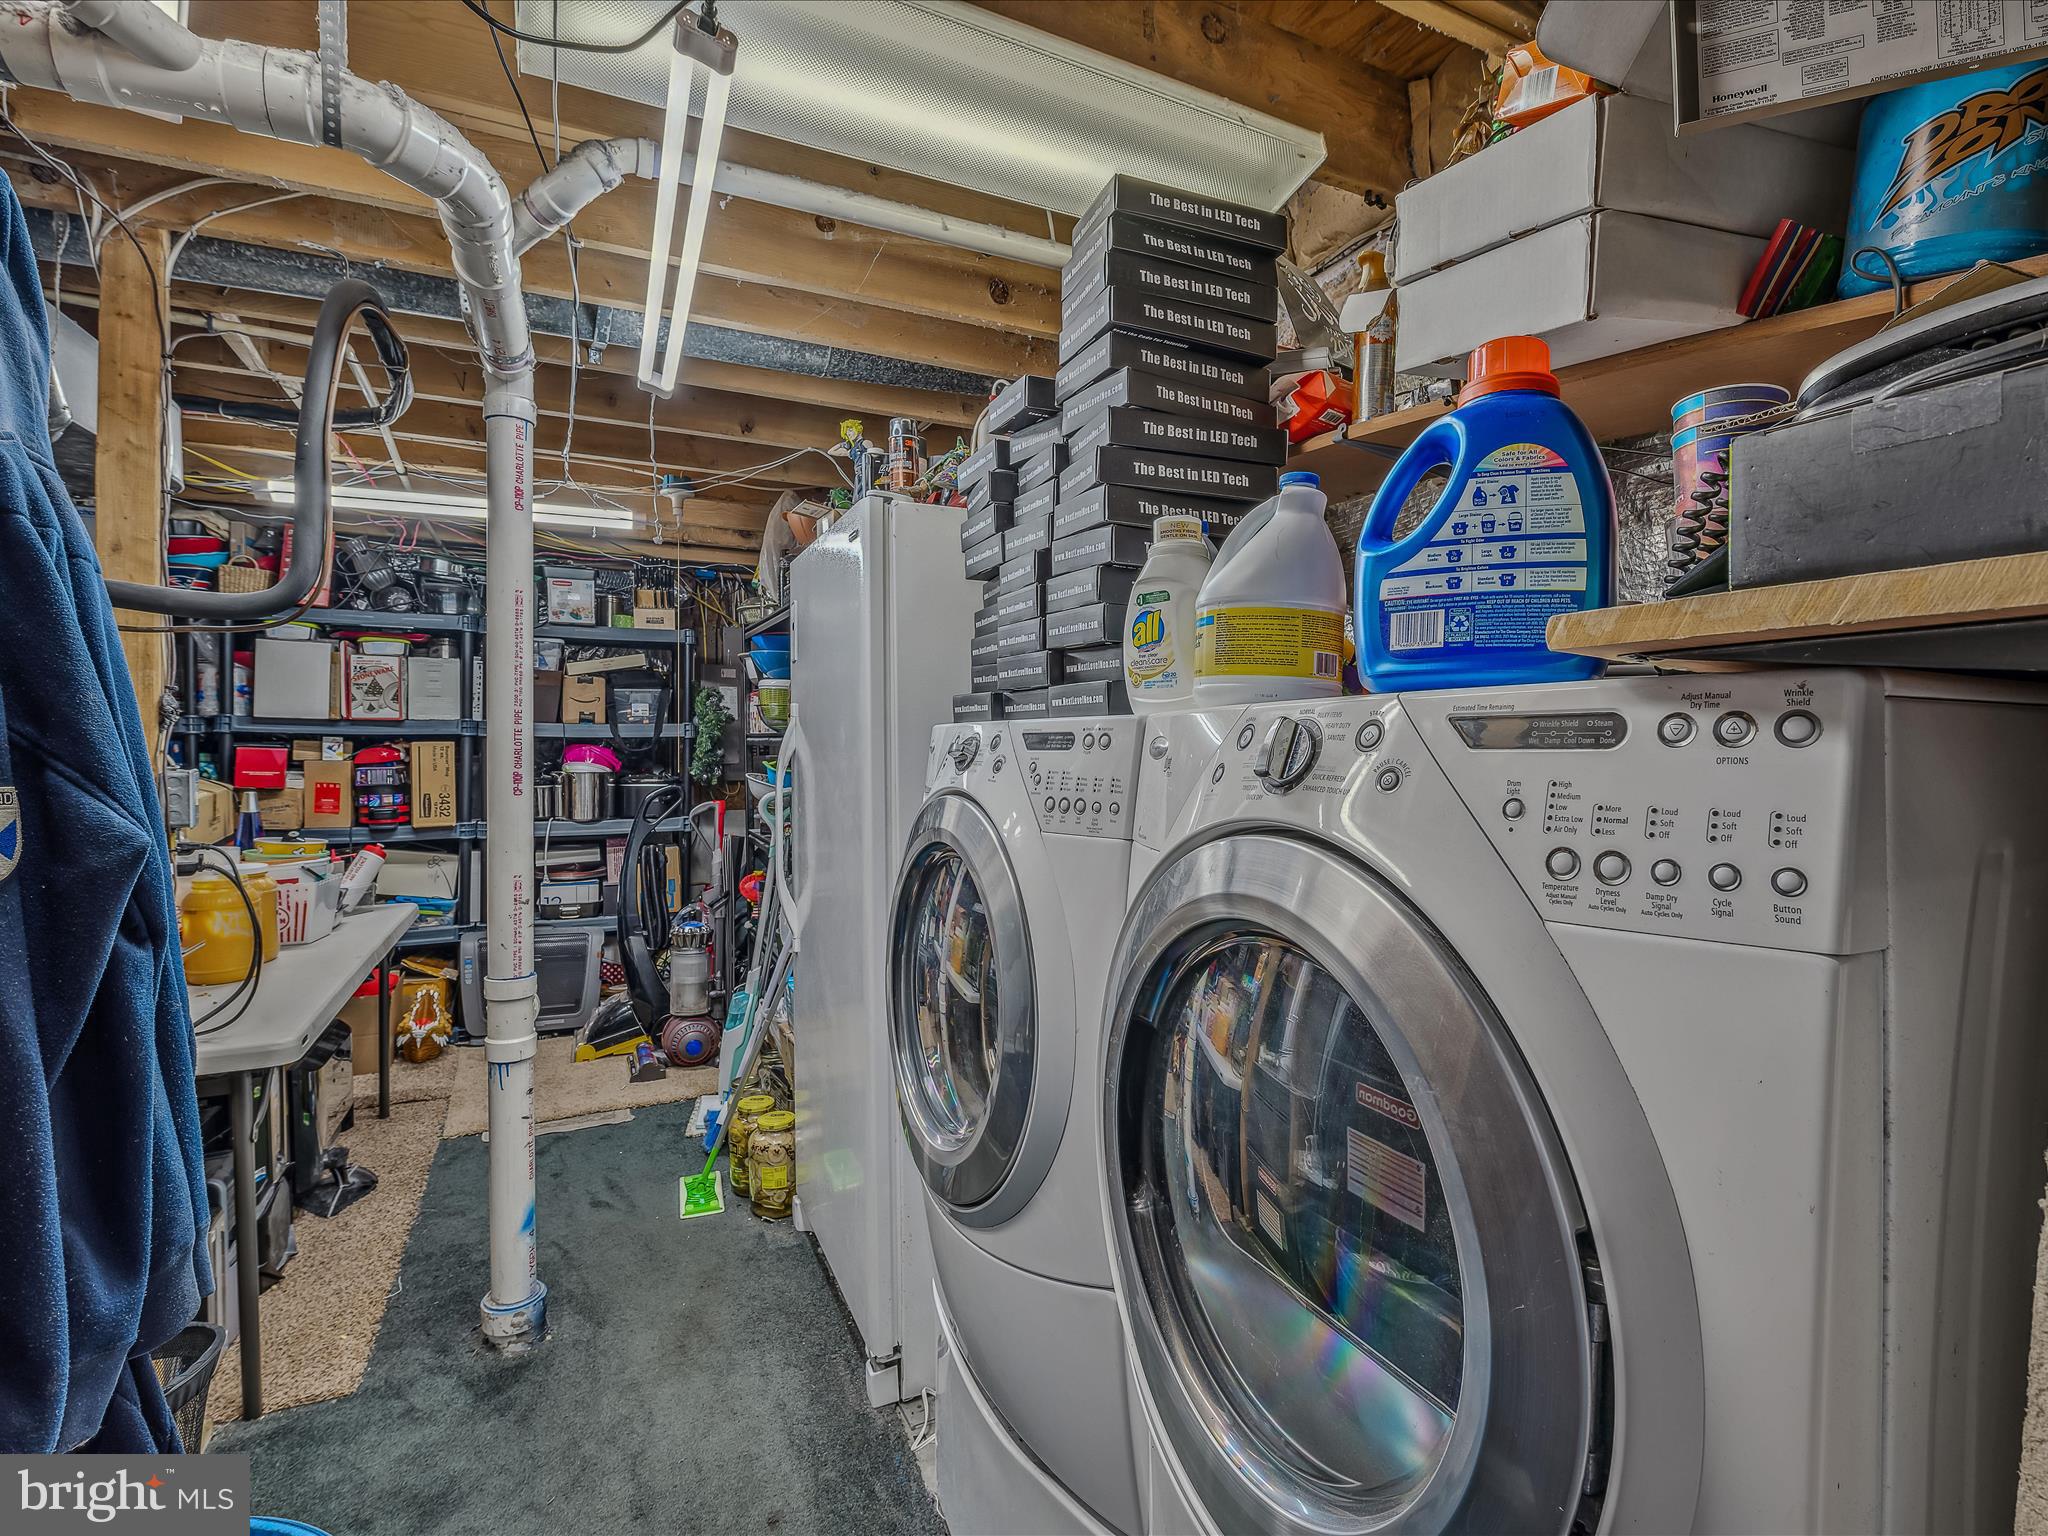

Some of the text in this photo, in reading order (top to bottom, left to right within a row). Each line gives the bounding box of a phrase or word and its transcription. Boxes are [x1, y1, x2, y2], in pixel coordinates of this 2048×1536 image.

[1870, 73, 1898, 82] ADEMCO
[1712, 84, 1768, 103] Honeywell
[1150, 192, 1260, 231] The Best in LED Tech
[1144, 234, 1251, 270] The Best in LED Tech
[1140, 270, 1251, 304] The Best in LED Tech
[1144, 304, 1251, 340] The Best in LED Tech
[1141, 349, 1244, 385] The Best in LED Tech
[1156, 385, 1253, 420] The Best in LED Tech
[516, 424, 524, 440] PIPE
[1143, 421, 1258, 448] The Best in LED Tech
[516, 443, 524, 484] CHARLOTTE
[1133, 462, 1249, 487] The Best in LED Tech
[1139, 501, 1159, 516] The
[1202, 509, 1219, 524] LED
[1133, 610, 1161, 647] all
[1681, 691, 1731, 701] Adjust Manual
[1452, 704, 1476, 712] Estimated
[1690, 702, 1702, 710] Dry
[514, 709, 522, 724] PIPE
[1544, 737, 1561, 745] Damp
[514, 728, 522, 769] CHARLOTTE
[1716, 757, 1749, 765] OPTIONS
[1373, 759, 1411, 778] PAUSE CANCEL
[1327, 787, 1342, 795] TOUCH
[439, 792, 450, 817] 3432
[1661, 808, 1678, 816] Loud
[1723, 810, 1741, 818] Loud
[1554, 815, 1570, 823] Extra
[1786, 814, 1806, 823] Loud
[1660, 820, 1674, 828] Soft
[1722, 822, 1737, 830] Soft
[1563, 826, 1577, 835] Only
[1659, 831, 1670, 839] Off
[1786, 827, 1803, 836] Soft
[1542, 882, 1579, 892] Temperature
[1596, 888, 1620, 898] Dryness
[1646, 893, 1678, 903] Damp Dry
[1600, 898, 1616, 906] Level
[1652, 902, 1672, 911] Signal
[1712, 899, 1732, 908] Cycle
[1615, 906, 1626, 914] Only
[1654, 910, 1669, 918] Cycles
[1711, 908, 1734, 918] Signal
[1773, 904, 1802, 914] Button
[1775, 915, 1801, 925] Sound
